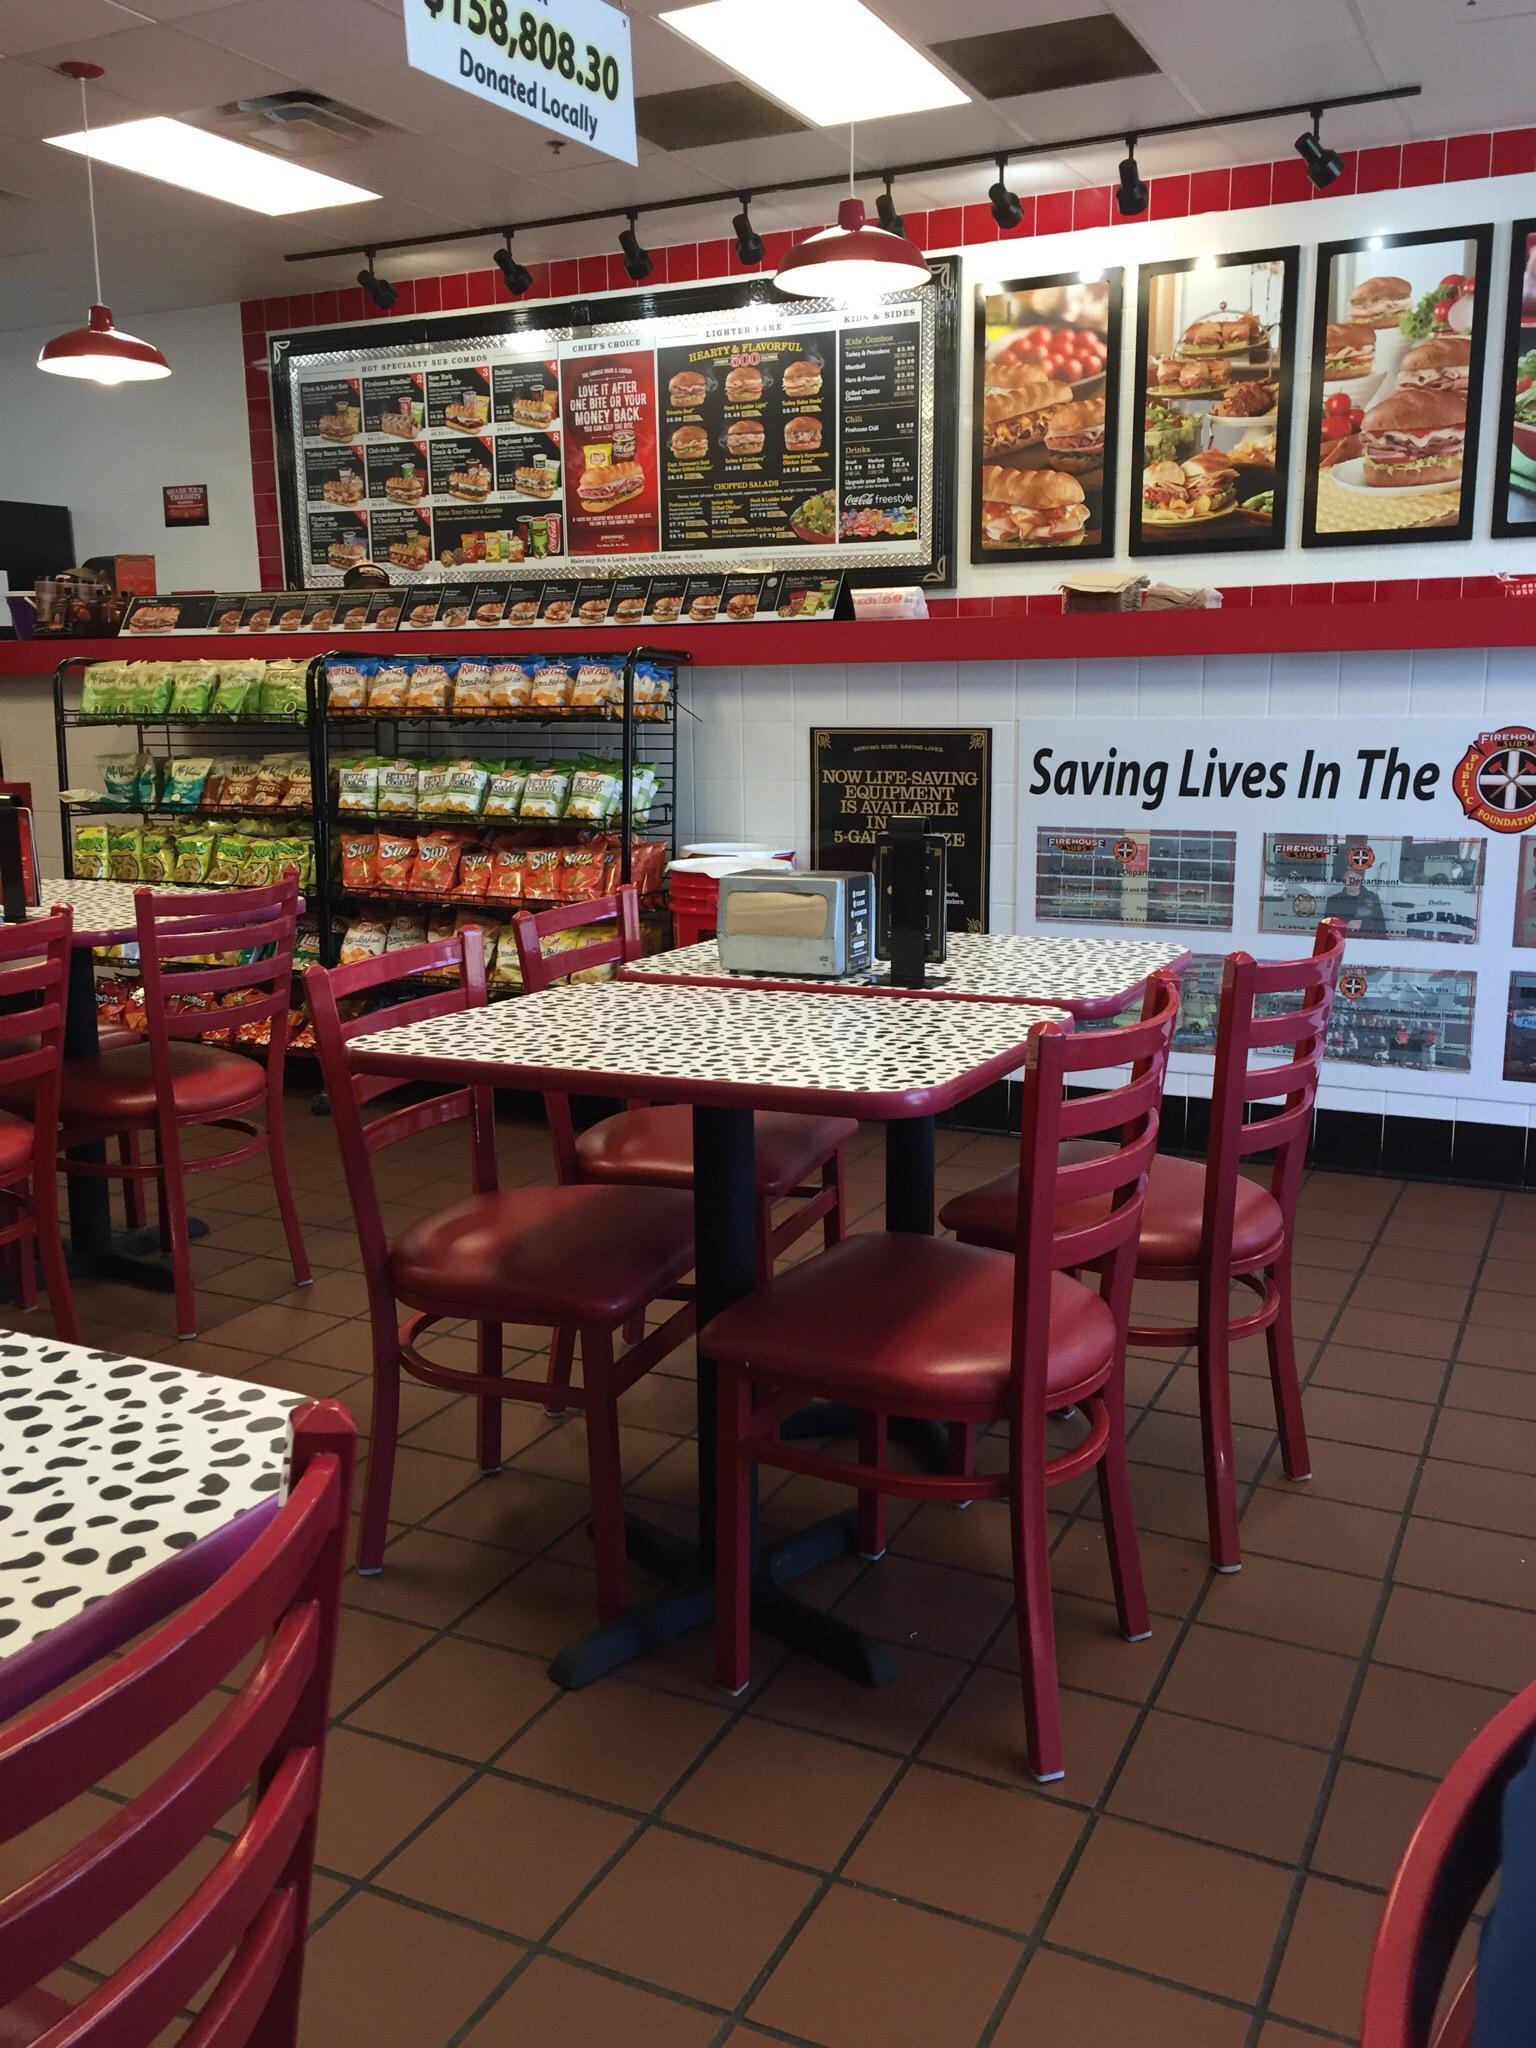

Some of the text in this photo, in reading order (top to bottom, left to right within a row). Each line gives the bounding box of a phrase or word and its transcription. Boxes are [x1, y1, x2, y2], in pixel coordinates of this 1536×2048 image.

[460, 48, 598, 141] Donated Locally
[844, 315, 869, 324] KIDS
[884, 308, 916, 319] SIDES
[706, 327, 750, 338] LIGHTER
[865, 335, 894, 344] Combos
[572, 339, 641, 353] CHIEF'S CHOICE
[689, 341, 803, 363] HEARTY & FLAVORFUL
[361, 354, 488, 373] HOT SPECIALTY SUB COMBOS
[730, 352, 761, 368] 500
[551, 362, 557, 371] 4
[483, 368, 489, 377] 3
[416, 375, 422, 383] 2
[353, 381, 359, 389] 1
[578, 381, 637, 397] LOVE IT AFTER
[570, 393, 647, 411] ONE BITE OR YOUR
[575, 407, 643, 426] MONEY BACK.
[845, 415, 863, 424] Chili
[485, 437, 491, 445] 7
[553, 432, 559, 441] 8
[419, 442, 425, 451] 6
[845, 446, 871, 455] Drinks
[714, 480, 779, 490] CHOPPED SALADS
[875, 493, 914, 504] freestyle
[421, 508, 429, 517] 10
[1481, 733, 1536, 745] FIREHOU
[854, 744, 880, 752] SERVING
[386, 772, 416, 780] KETTLE
[452, 772, 479, 780] KETTLE
[822, 770, 979, 787] NOW LIFE-SAVING
[1030, 747, 1440, 810] Saving Lives In The
[1461, 754, 1479, 805] PUBLIC
[528, 778, 557, 786] KETTLE
[229, 786, 248, 794] BBQ
[255, 784, 275, 793] BBQ
[289, 786, 309, 795] BBQ
[527, 785, 555, 793] COOKED
[844, 785, 955, 801] EQUIPMENT
[840, 800, 959, 816] IS AVAILABLE
[866, 816, 888, 829] IN
[1477, 808, 1536, 827] FOUNDATIO
[1049, 838, 1105, 848] FIREHOUSE
[347, 843, 374, 858] Sun
[381, 843, 412, 858] Sun
[421, 844, 448, 860] Sun
[1274, 845, 1338, 855] FIREHOUSE
[531, 851, 557, 869] Sun
[564, 853, 592, 865] Sun
[1061, 866, 1168, 879] Highway Fire Department
[1287, 875, 1304, 884] Red
[1307, 876, 1328, 884] Bank
[1330, 877, 1347, 885] Fire
[1350, 878, 1400, 887] Department
[95, 993, 118, 1004] oritos
